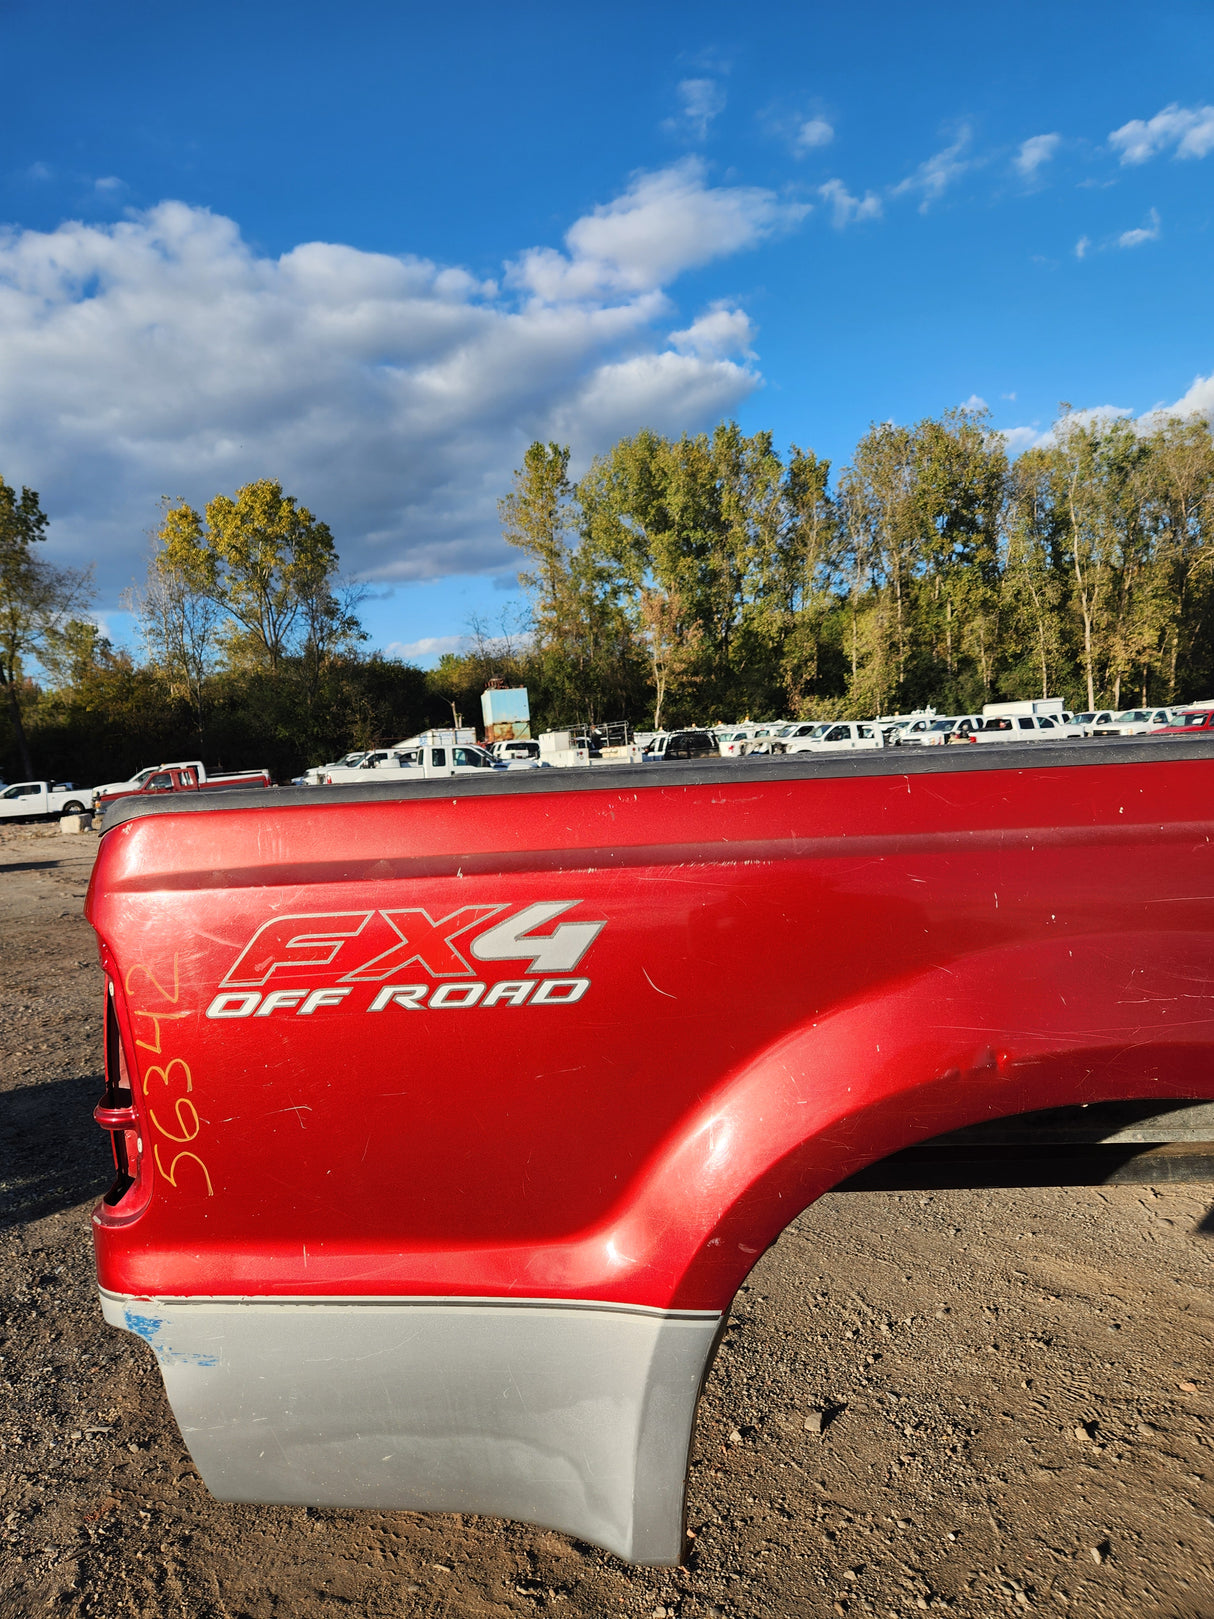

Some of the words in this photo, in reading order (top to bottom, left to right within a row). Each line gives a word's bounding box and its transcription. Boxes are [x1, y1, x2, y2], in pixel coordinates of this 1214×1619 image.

[218, 899, 608, 988] FX4
[205, 986, 354, 1019] OFF
[366, 976, 592, 1013] ROAD
[125, 951, 214, 1197] 56342
